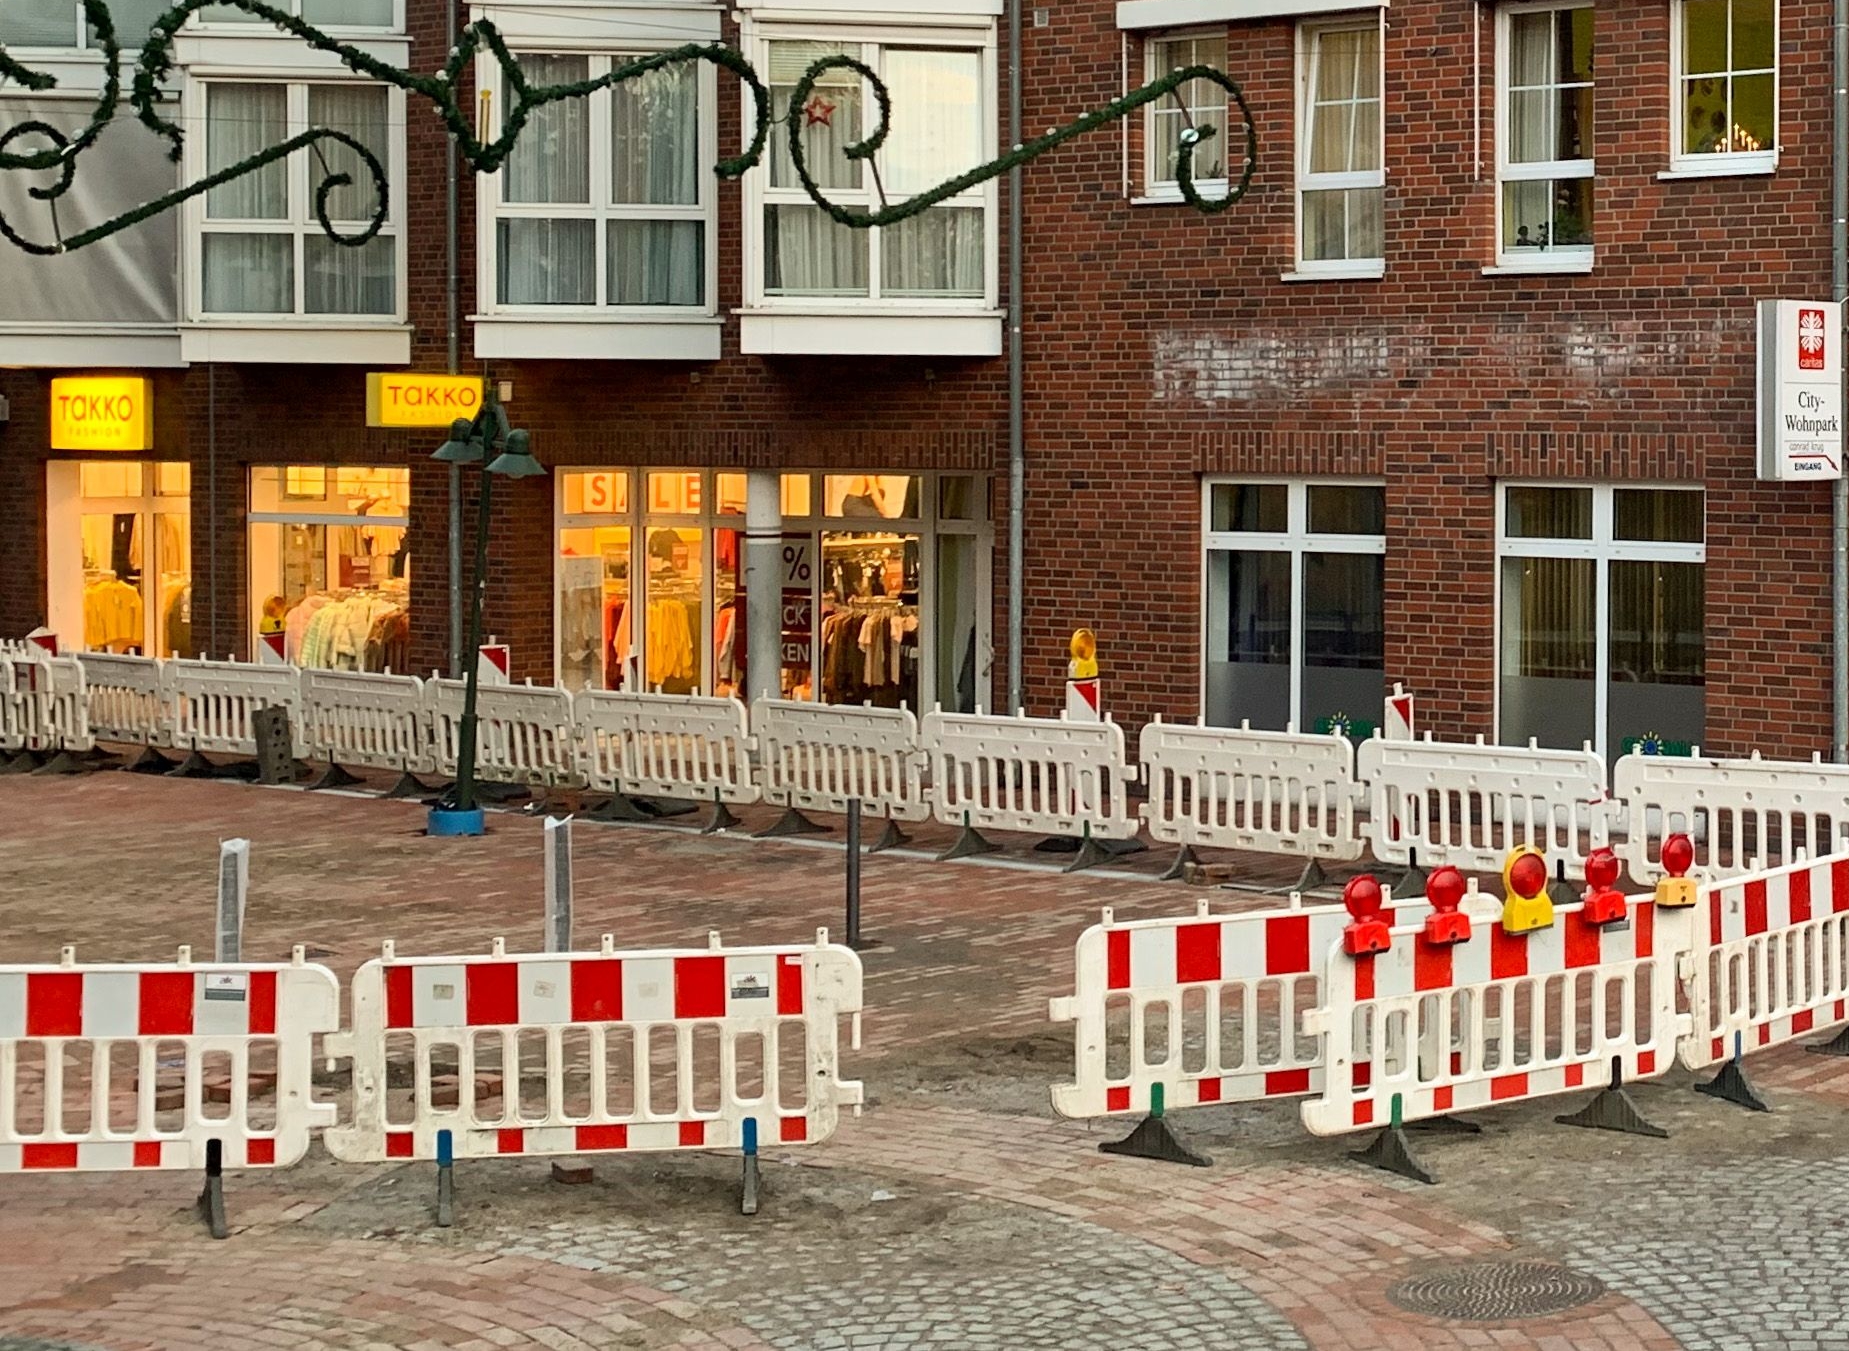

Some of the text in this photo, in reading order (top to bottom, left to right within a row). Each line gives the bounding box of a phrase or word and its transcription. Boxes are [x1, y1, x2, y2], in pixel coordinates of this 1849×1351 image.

[1799, 357, 1824, 368] caritas
[1798, 391, 1826, 413] City-
[1784, 414, 1839, 437] Wohnpark
[1794, 462, 1822, 471] EINGANG
[591, 475, 701, 509] SLE
